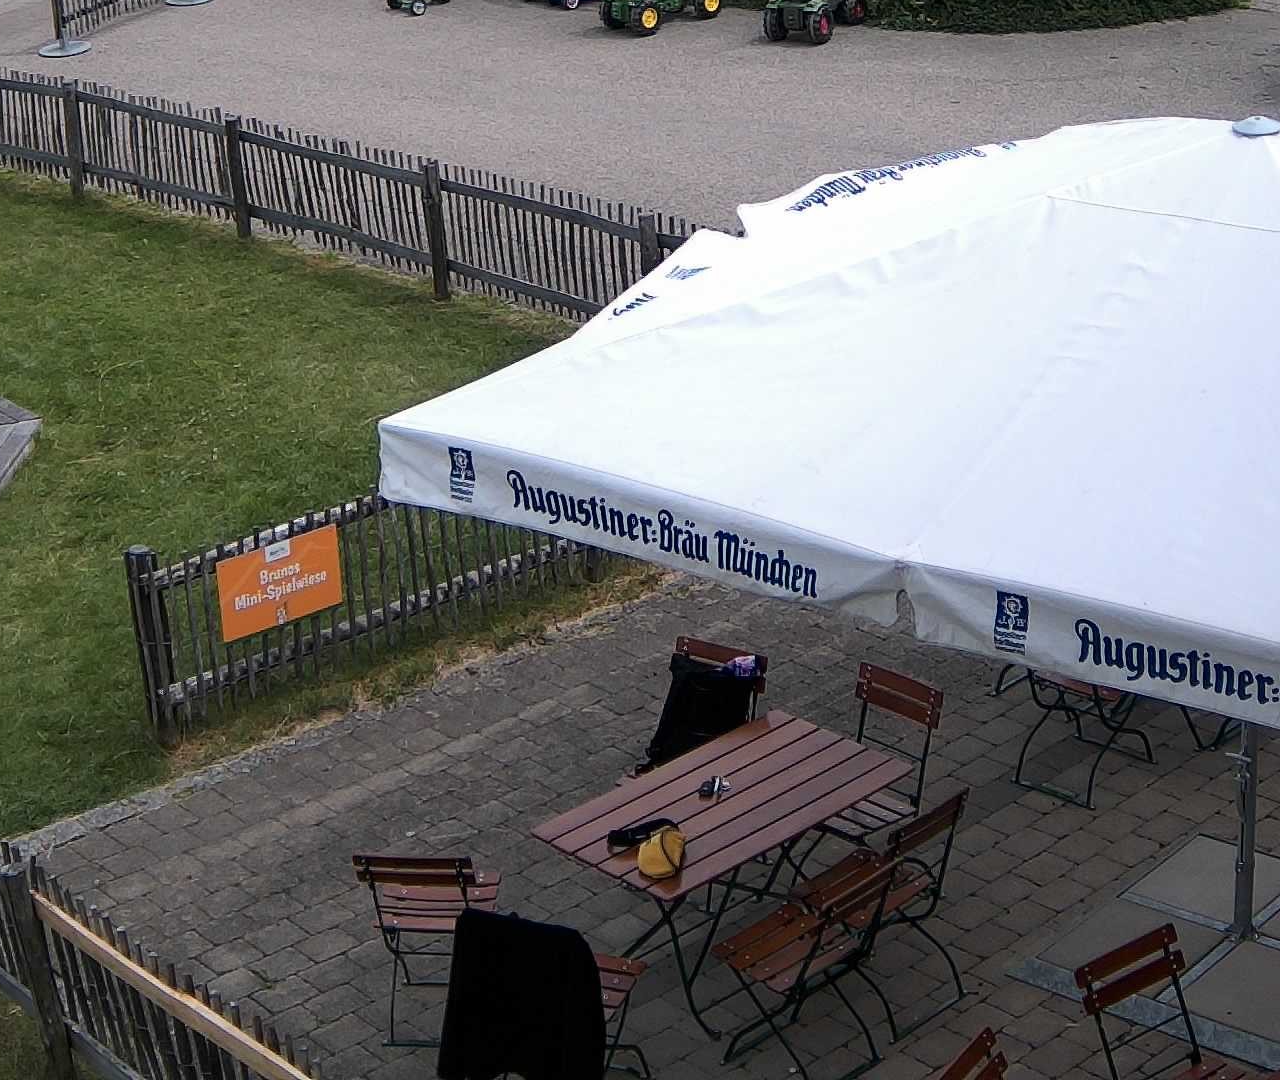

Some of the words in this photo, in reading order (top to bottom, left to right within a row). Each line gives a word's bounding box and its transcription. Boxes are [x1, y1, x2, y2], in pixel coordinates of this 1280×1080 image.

[259, 562, 301, 585] Brunos
[714, 529, 818, 599] München
[234, 570, 327, 610] Mini-Spielwiese
